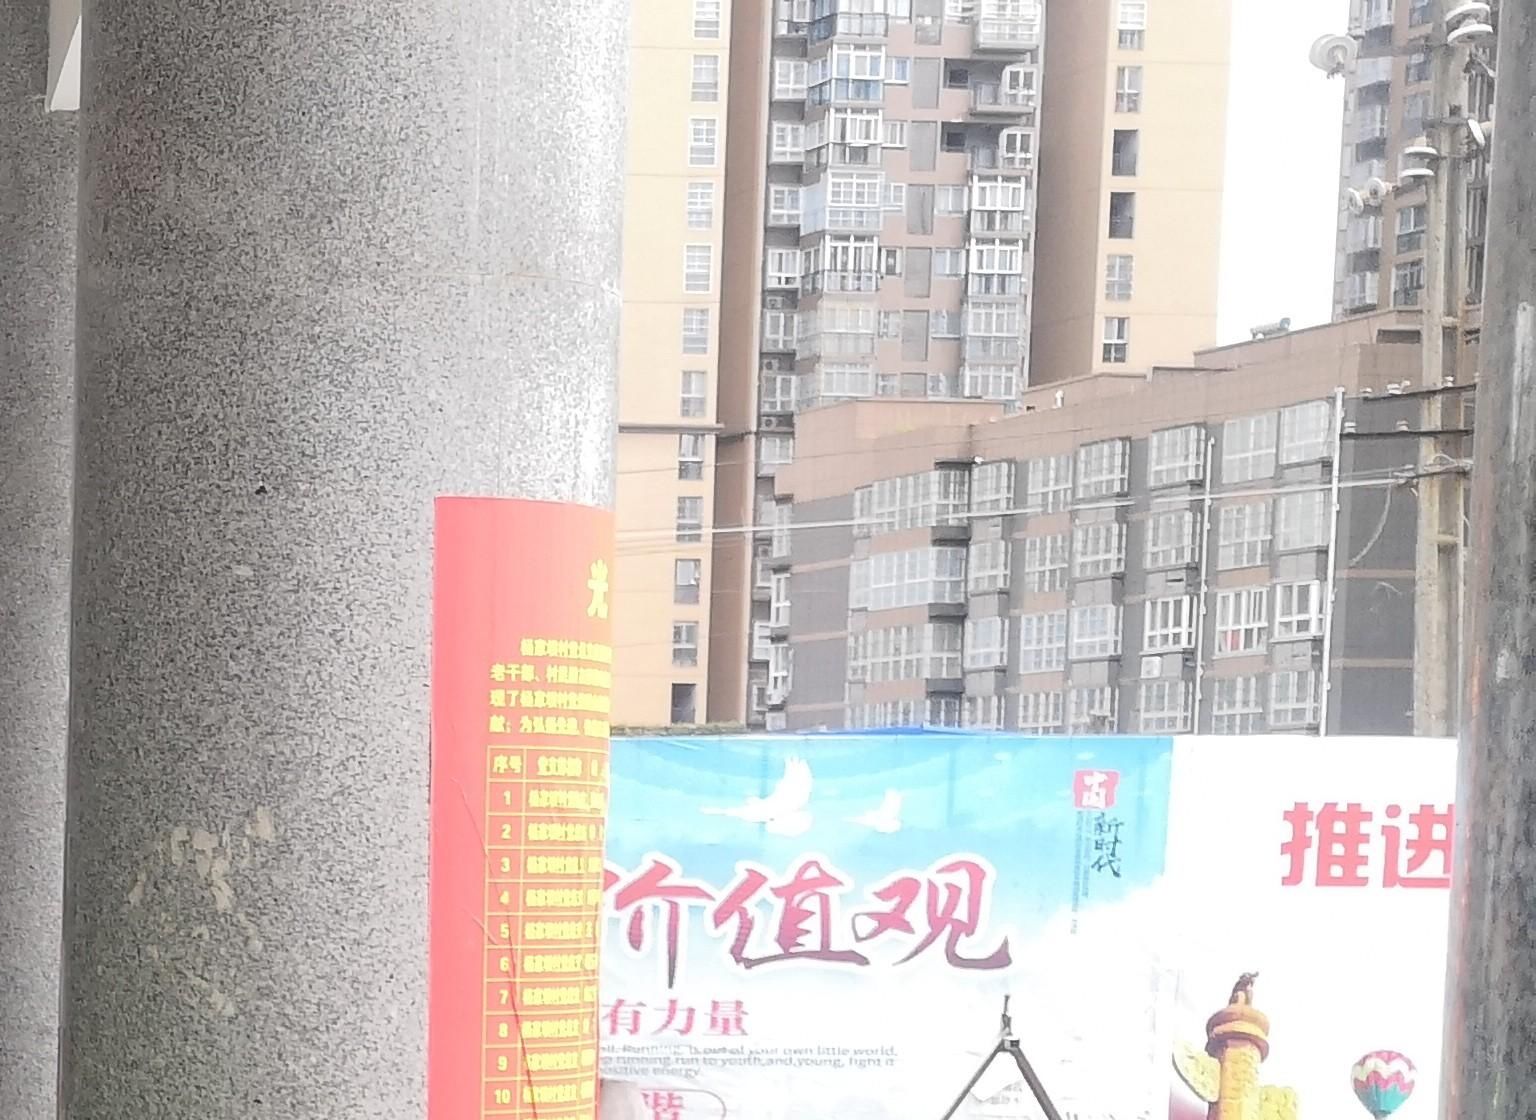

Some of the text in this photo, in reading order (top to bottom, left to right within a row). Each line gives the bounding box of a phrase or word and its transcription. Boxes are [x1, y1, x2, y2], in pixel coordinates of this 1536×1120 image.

[1281, 802, 1455, 889] 推进
[604, 860, 1013, 989] 价值观
[602, 998, 749, 1036] 有力量
